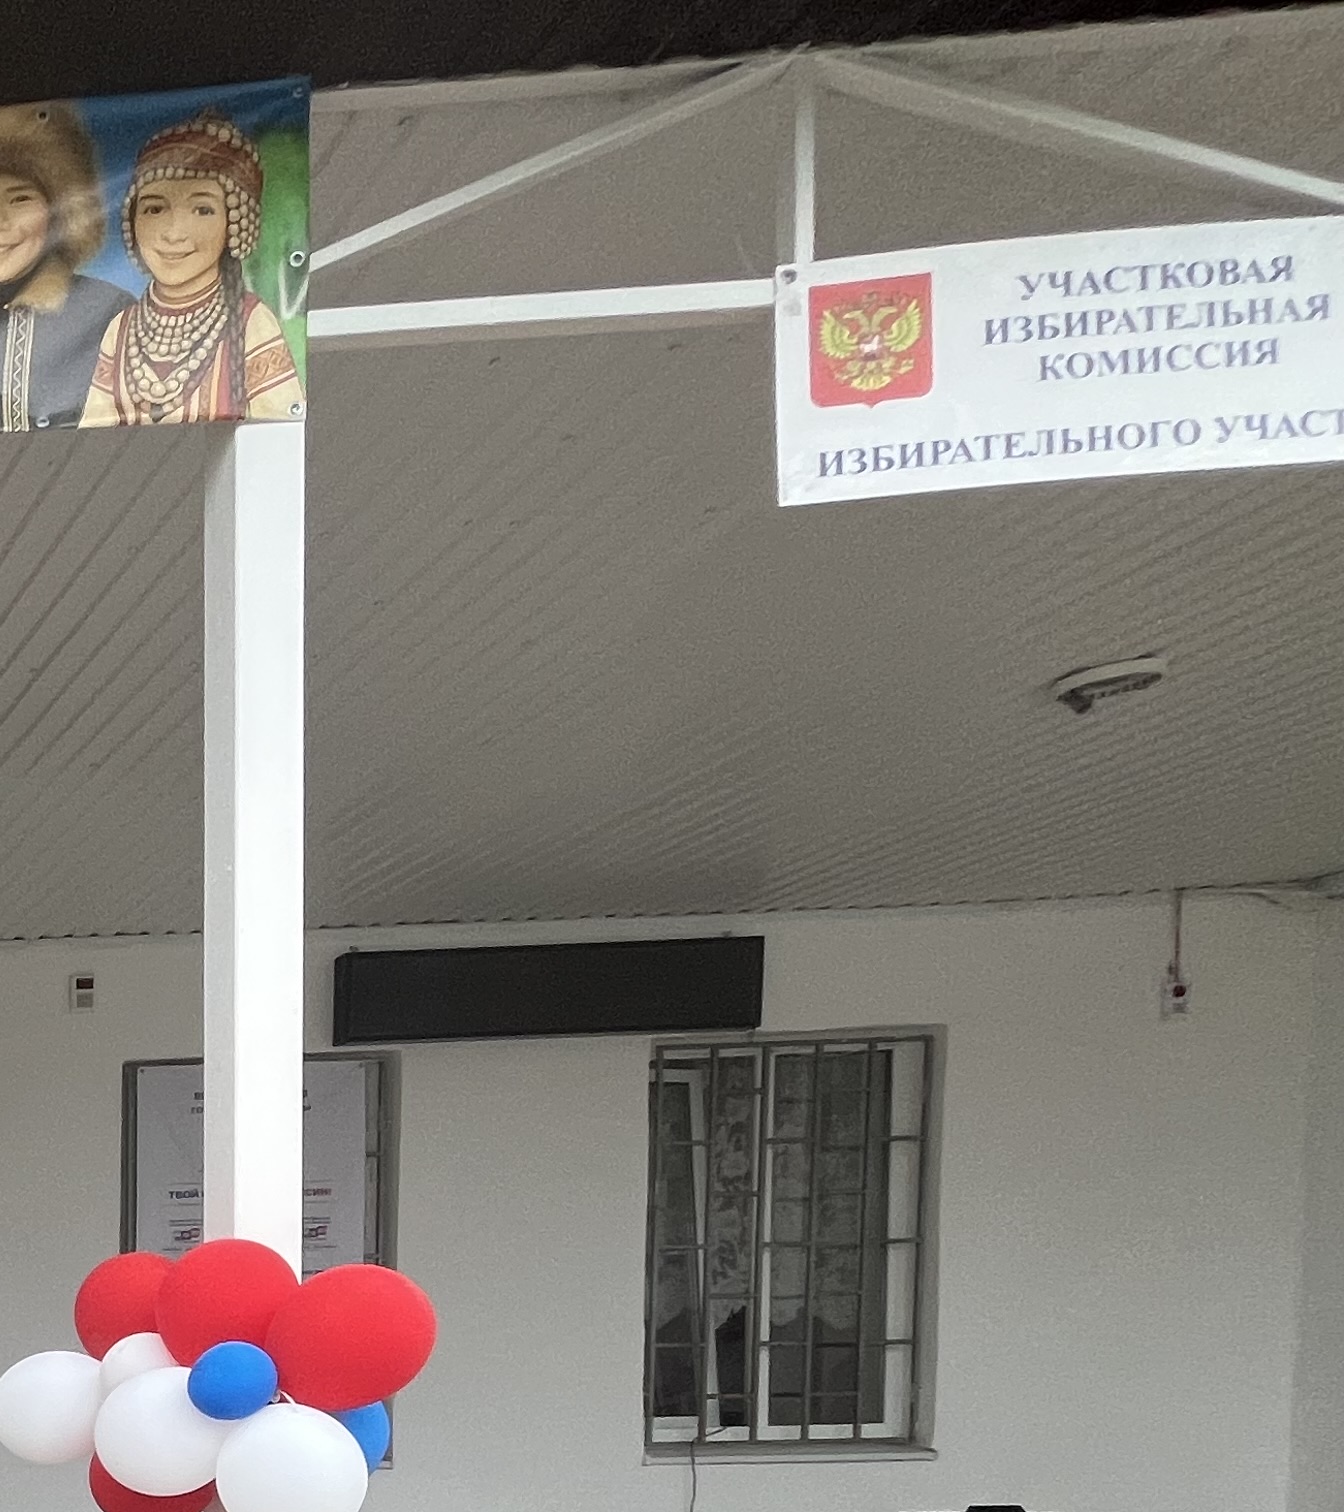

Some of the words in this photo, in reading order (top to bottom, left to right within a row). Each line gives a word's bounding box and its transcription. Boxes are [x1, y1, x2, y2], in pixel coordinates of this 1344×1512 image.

[1016, 255, 1294, 300] УЧАСТКОВАЯ
[984, 293, 1331, 346] ИЗБИРАТЕЛЬНАЯ
[1038, 338, 1280, 382] КОМИССИЯ
[818, 418, 1201, 478] ИЗБИРАТЕЛЬНОГО
